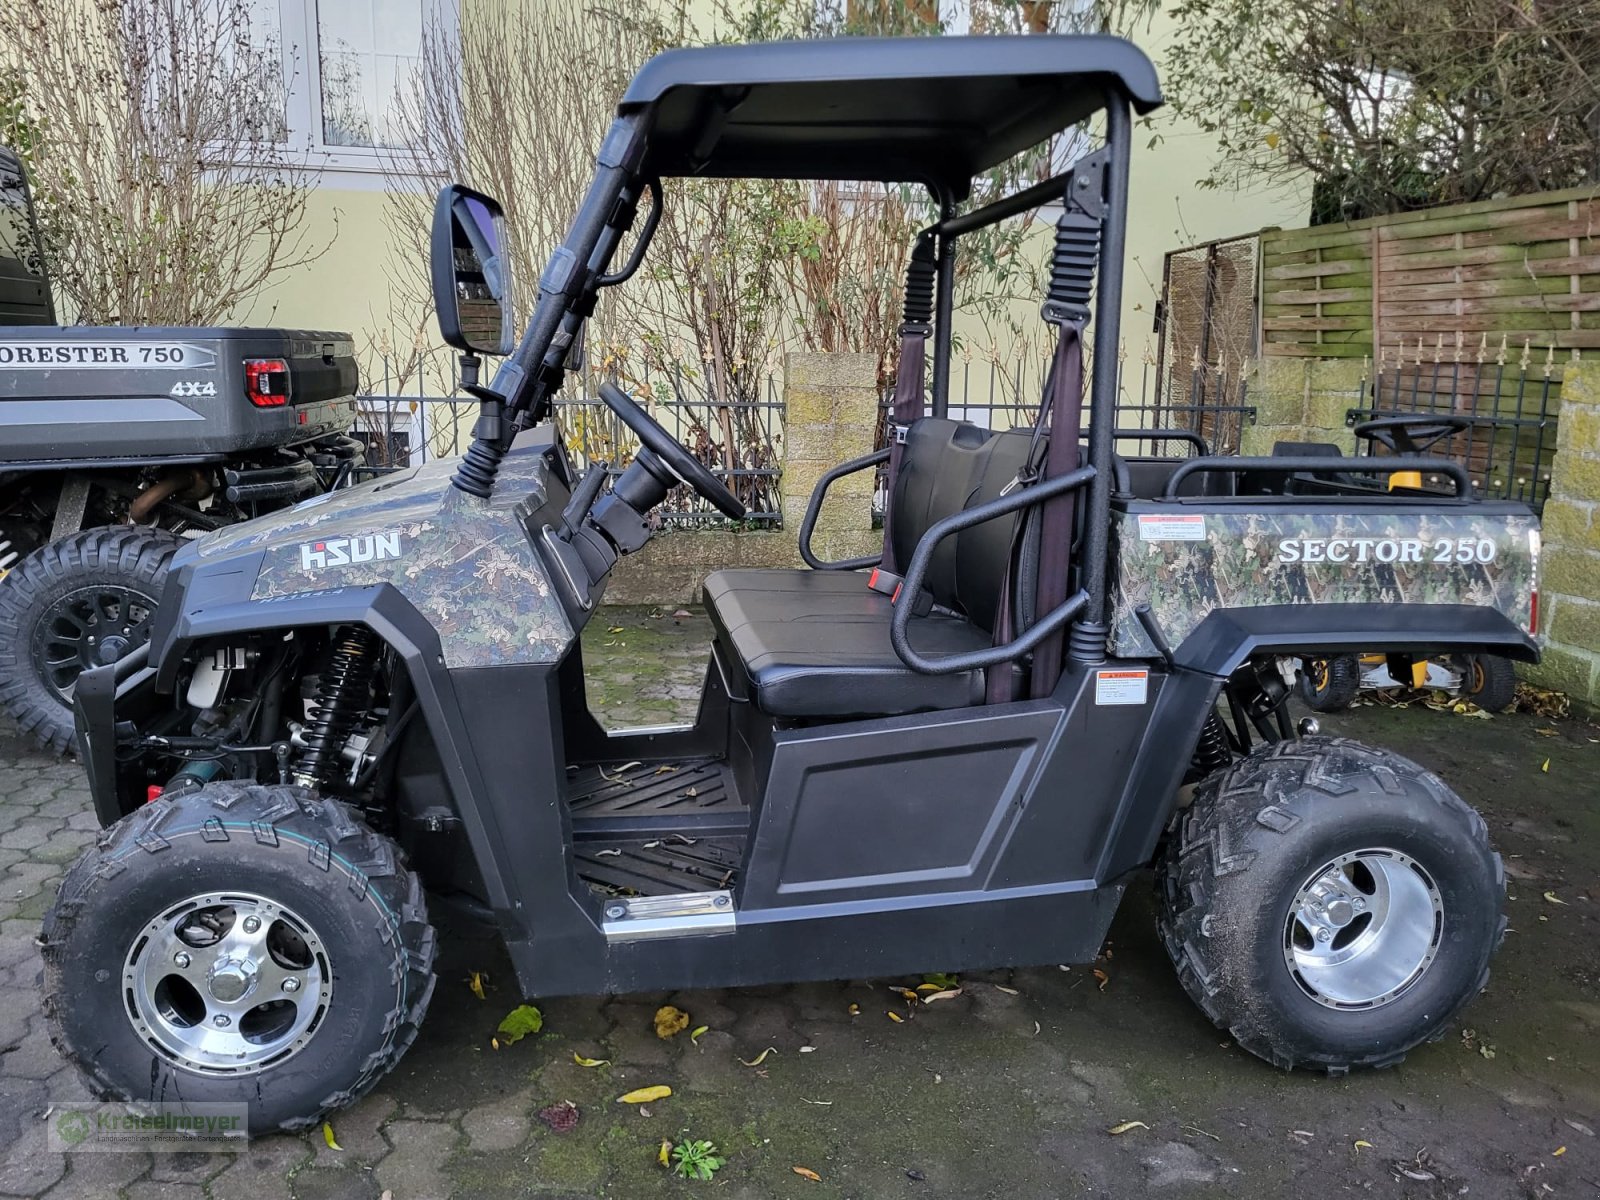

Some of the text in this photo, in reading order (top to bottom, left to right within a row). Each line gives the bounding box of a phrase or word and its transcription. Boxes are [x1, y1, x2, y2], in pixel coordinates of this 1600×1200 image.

[139, 347, 184, 363] 750
[1278, 538, 1497, 563] SECTOR 250
